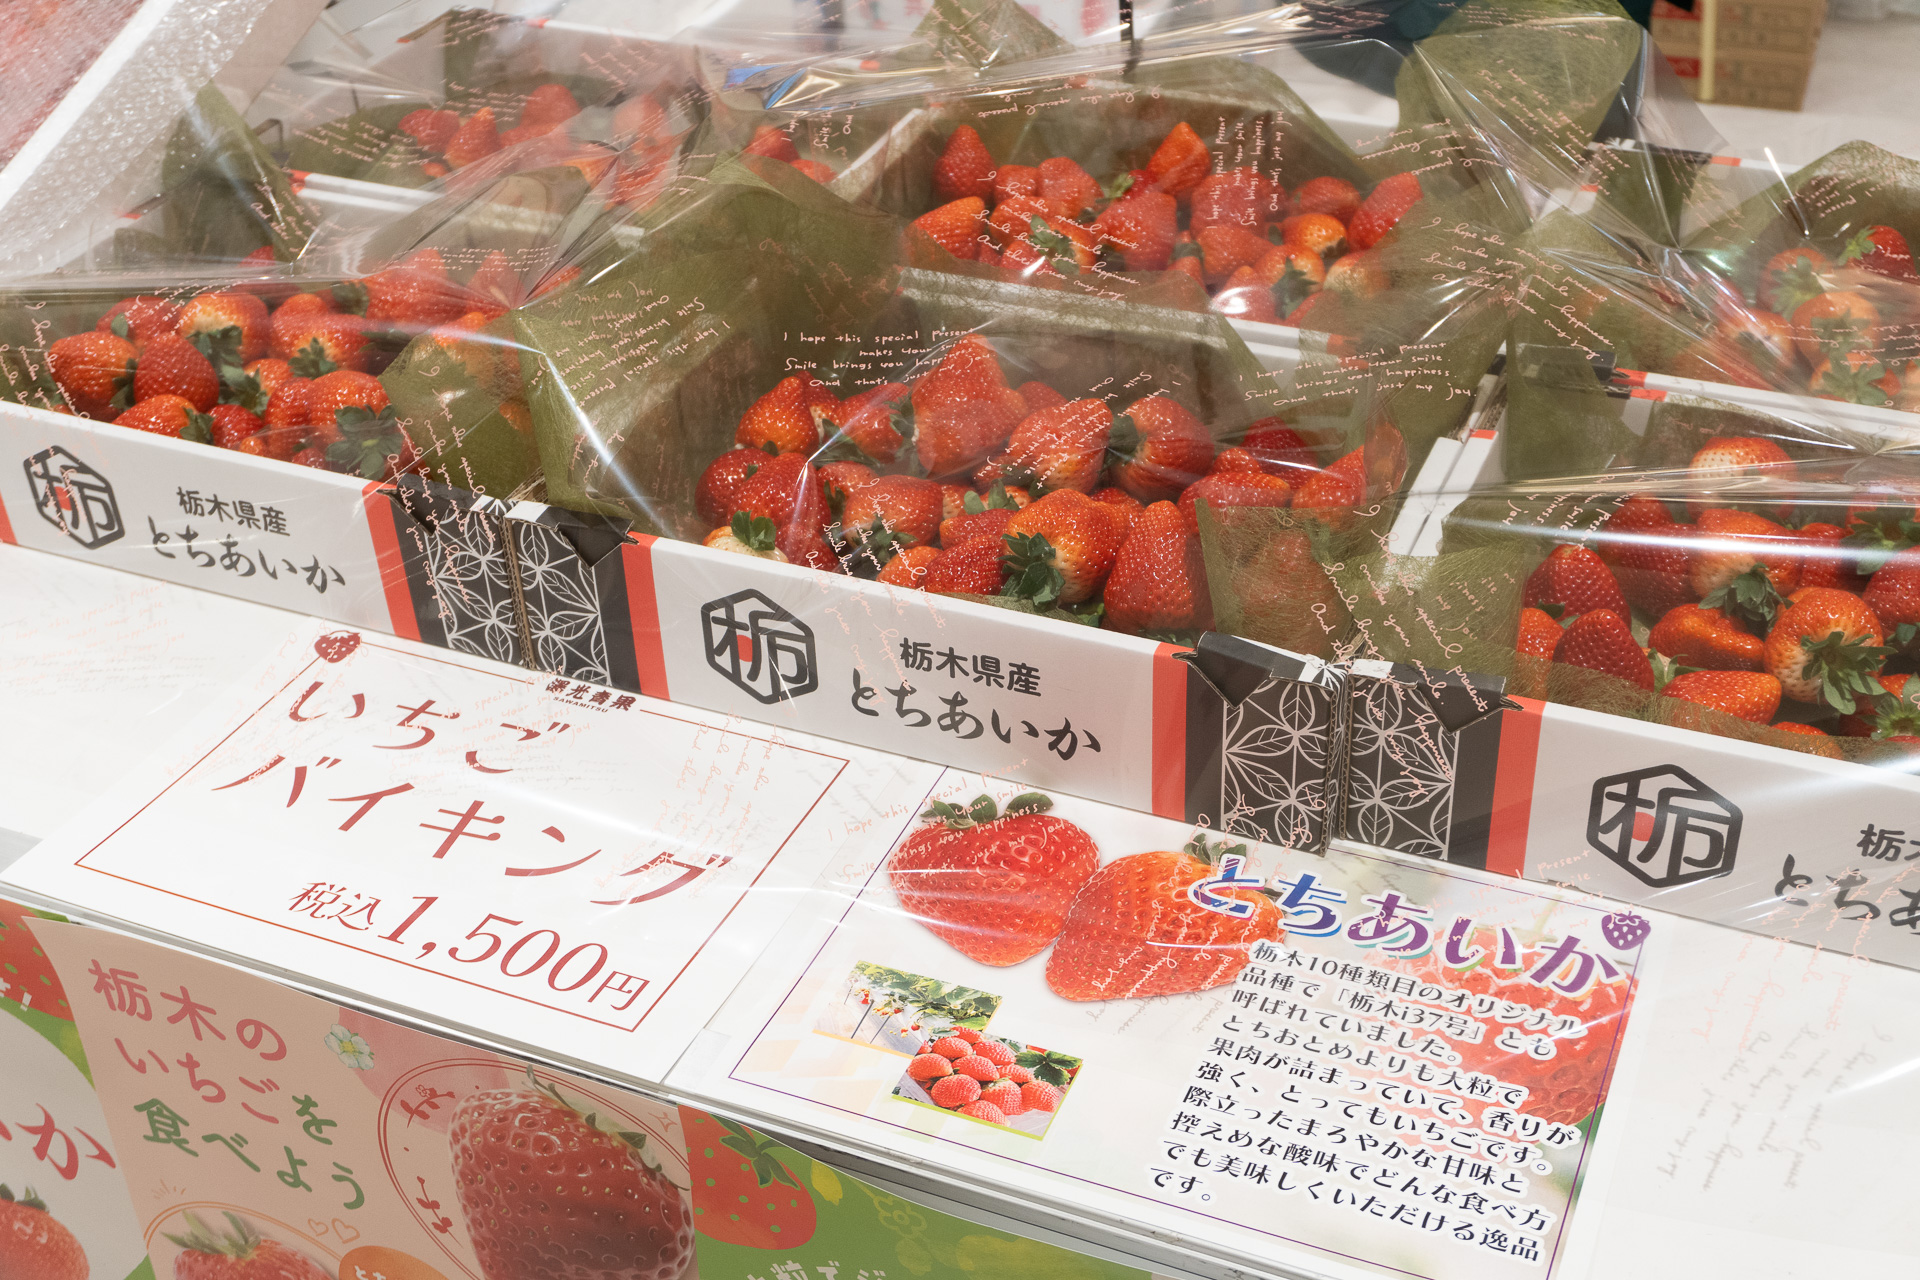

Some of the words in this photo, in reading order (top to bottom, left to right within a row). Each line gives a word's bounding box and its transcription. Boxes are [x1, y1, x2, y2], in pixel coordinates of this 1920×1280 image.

[148, 515, 345, 594] とちあいか
[176, 486, 290, 536] 栃木県産
[706, 594, 813, 699] 栃
[899, 637, 1042, 697] 栃木県産
[290, 681, 570, 774] いちご
[553, 696, 609, 713] SAWAMITSU
[851, 667, 1101, 760] とちあいか
[211, 756, 734, 905] バイキング
[1593, 770, 1737, 881] 栃
[289, 882, 650, 1011] 税込1,500円
[1192, 855, 1620, 992] とちあいか
[89, 959, 287, 1061] 栃木の
[1232, 990, 1460, 1062] 呼ばれていました。
[1254, 942, 1582, 1035] 栃木10種類目のオリジナル
[115, 1037, 338, 1145] いちごを
[1209, 1037, 1575, 1145] 果肉が詰まっていて、香りが
[1224, 1016, 1521, 1104] とちおとめよりも大粒で
[133, 1098, 364, 1210] 食べよう
[1183, 1085, 1522, 1193] 際立ったまろやかな甘味と
[1196, 1062, 1547, 1171] 強く、とってもいちごです。
[1150, 1169, 1210, 1202] です。
[1164, 1139, 1539, 1261] でも美味しくいただける逸品
[1171, 1112, 1552, 1233] 控えめな酸味でどんな食べ方
